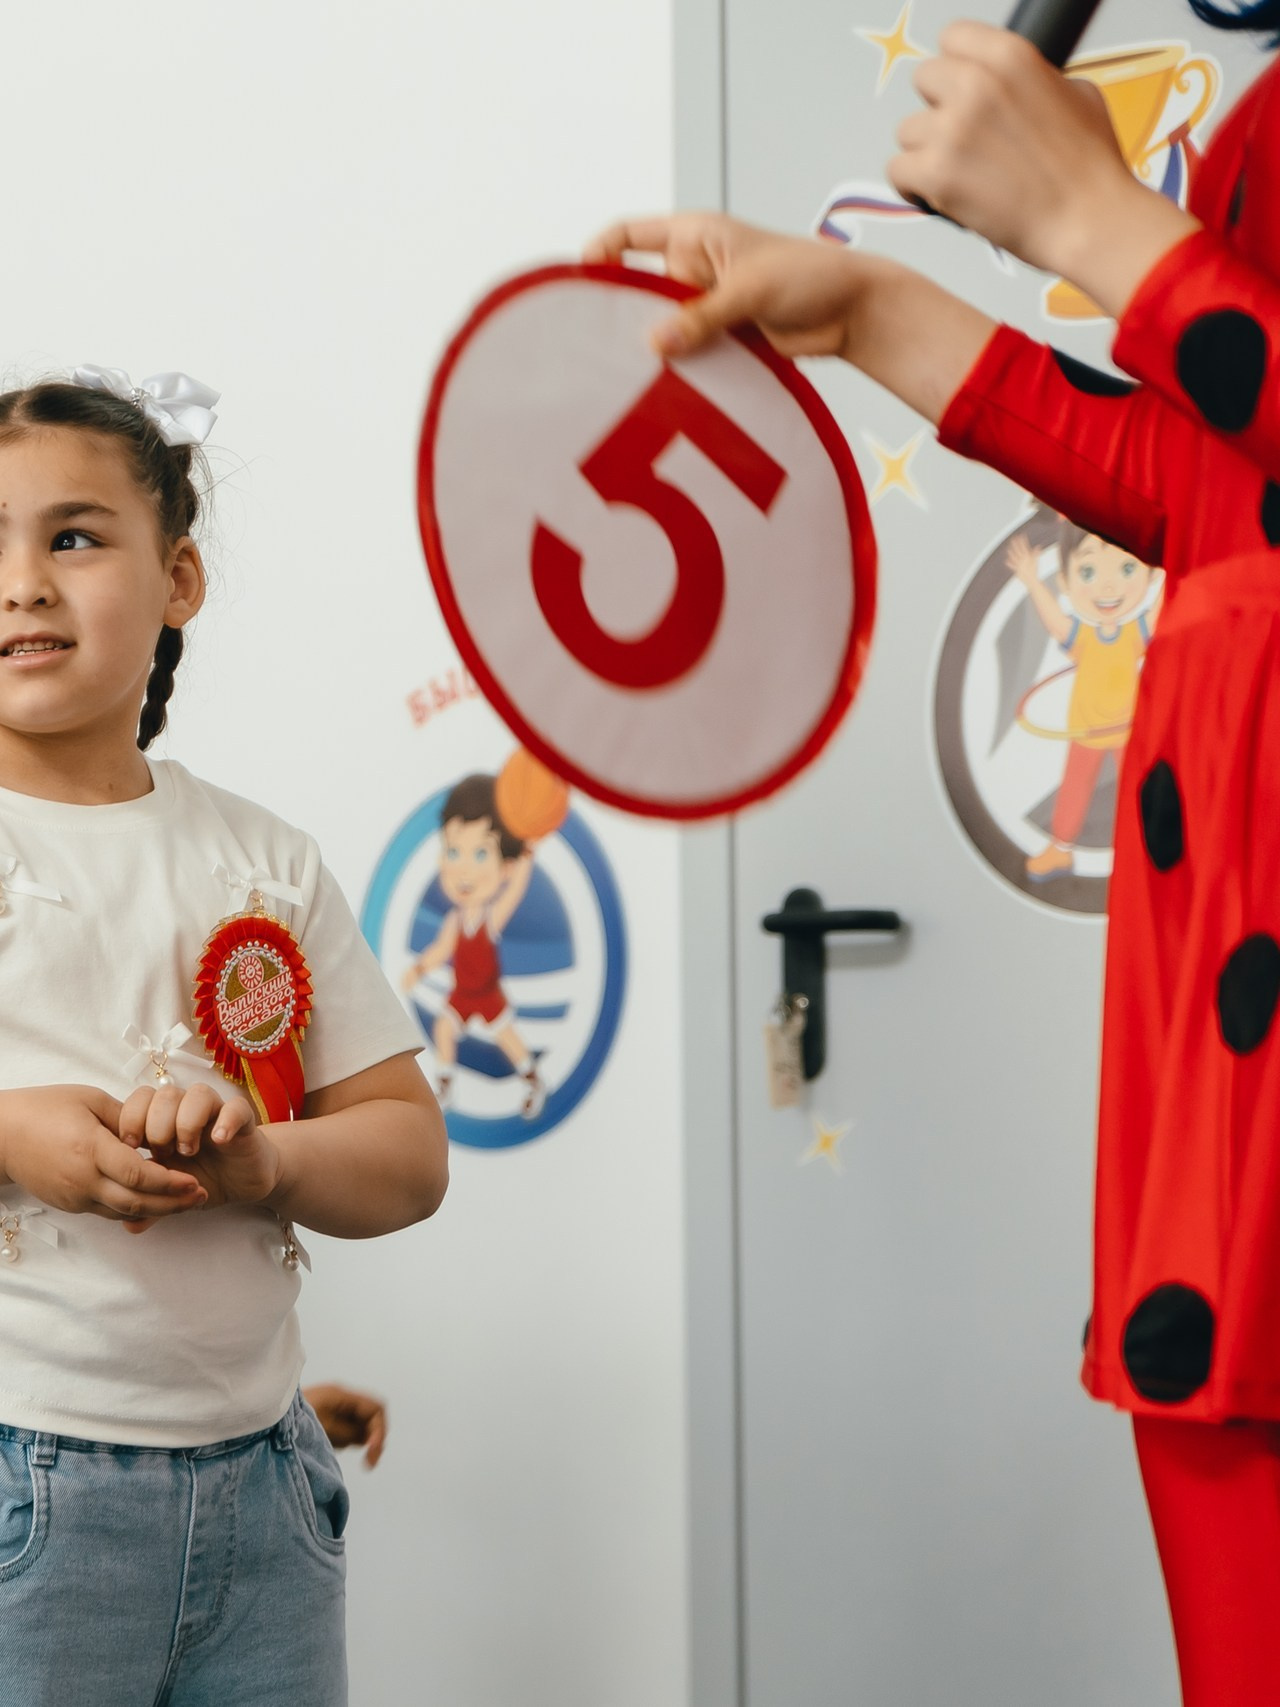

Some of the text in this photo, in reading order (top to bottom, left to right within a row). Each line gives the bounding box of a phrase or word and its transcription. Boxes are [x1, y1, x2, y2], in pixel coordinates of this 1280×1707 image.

[531, 362, 788, 690] 5
[217, 971, 293, 1024] Выпускник
[225, 986, 292, 1032] детского
[237, 1003, 285, 1034] сада
